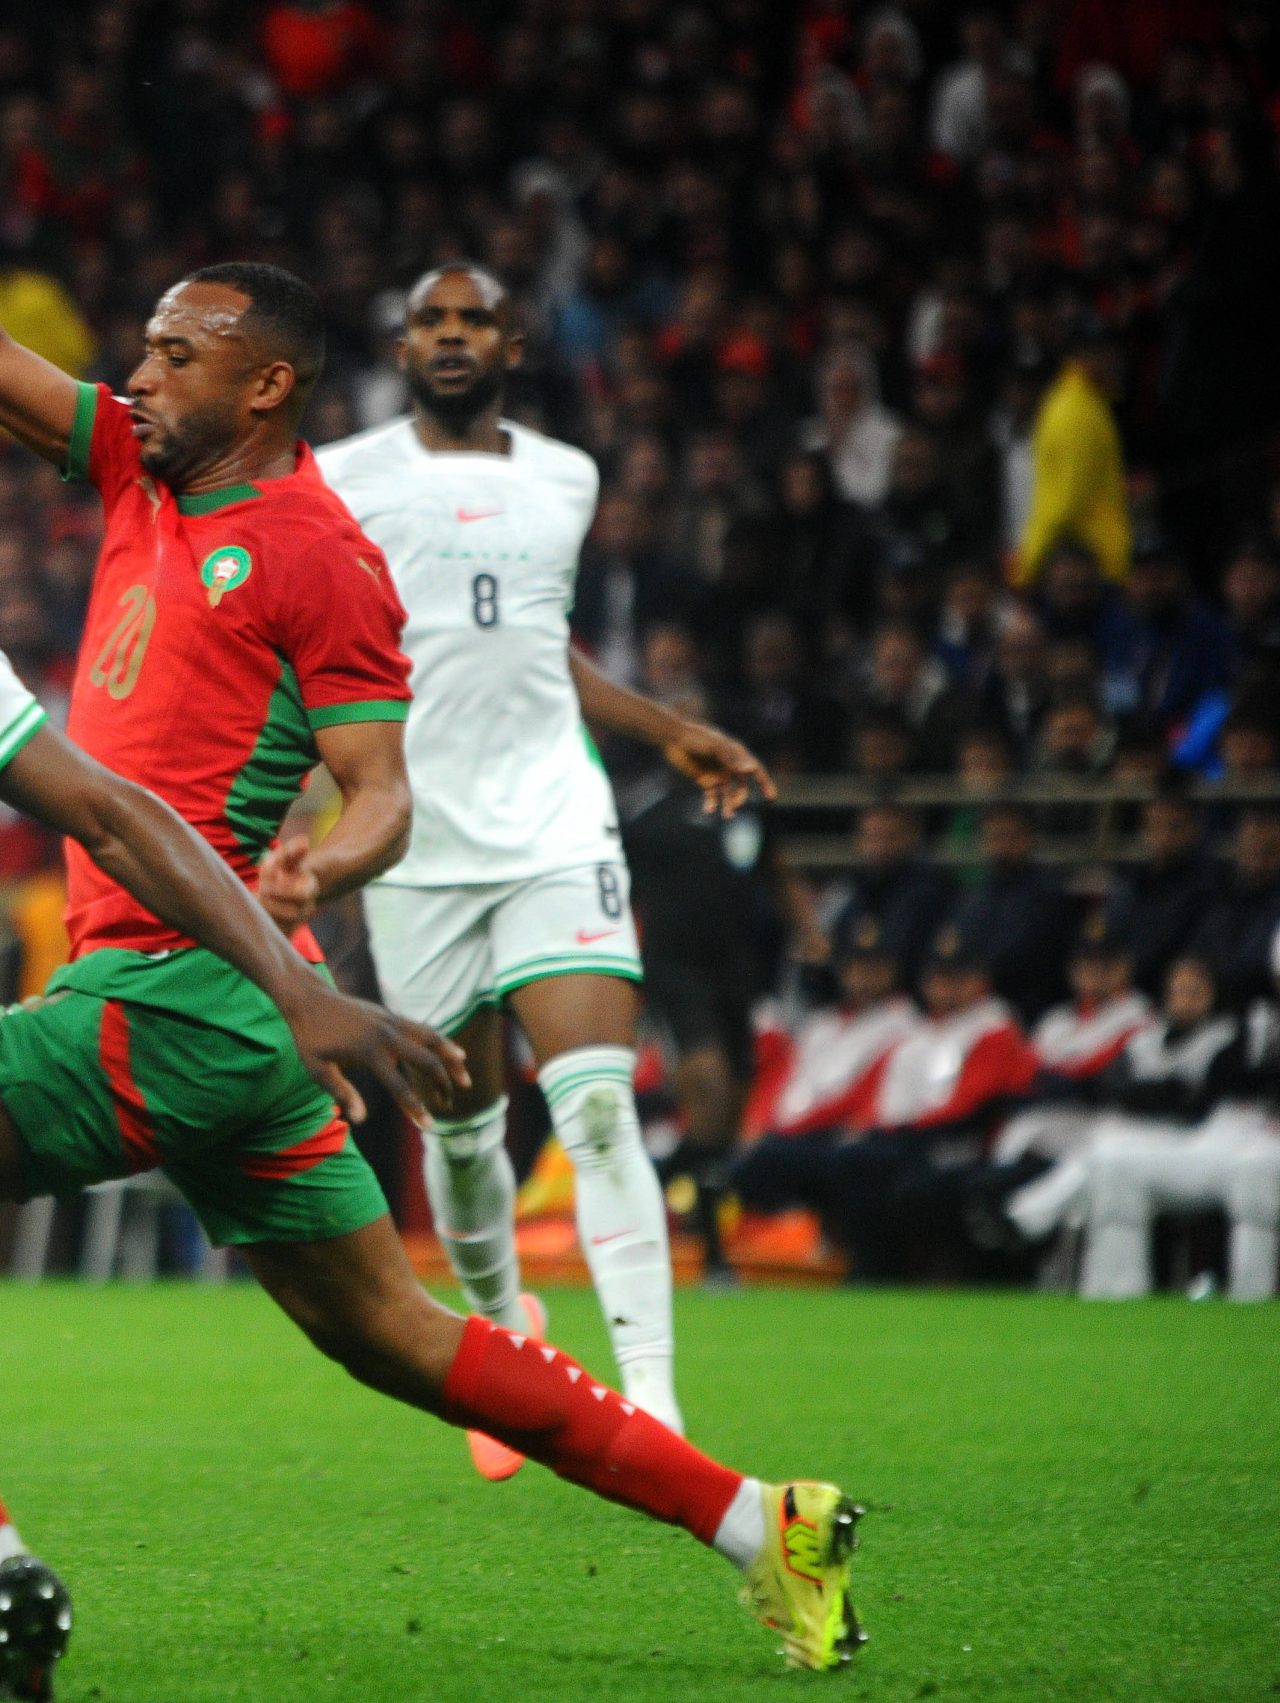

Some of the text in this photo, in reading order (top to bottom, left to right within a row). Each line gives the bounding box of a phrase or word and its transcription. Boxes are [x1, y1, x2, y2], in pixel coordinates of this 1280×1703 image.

[472, 572, 499, 628] 8
[91, 585, 157, 700] 20
[598, 866, 622, 922] 8
